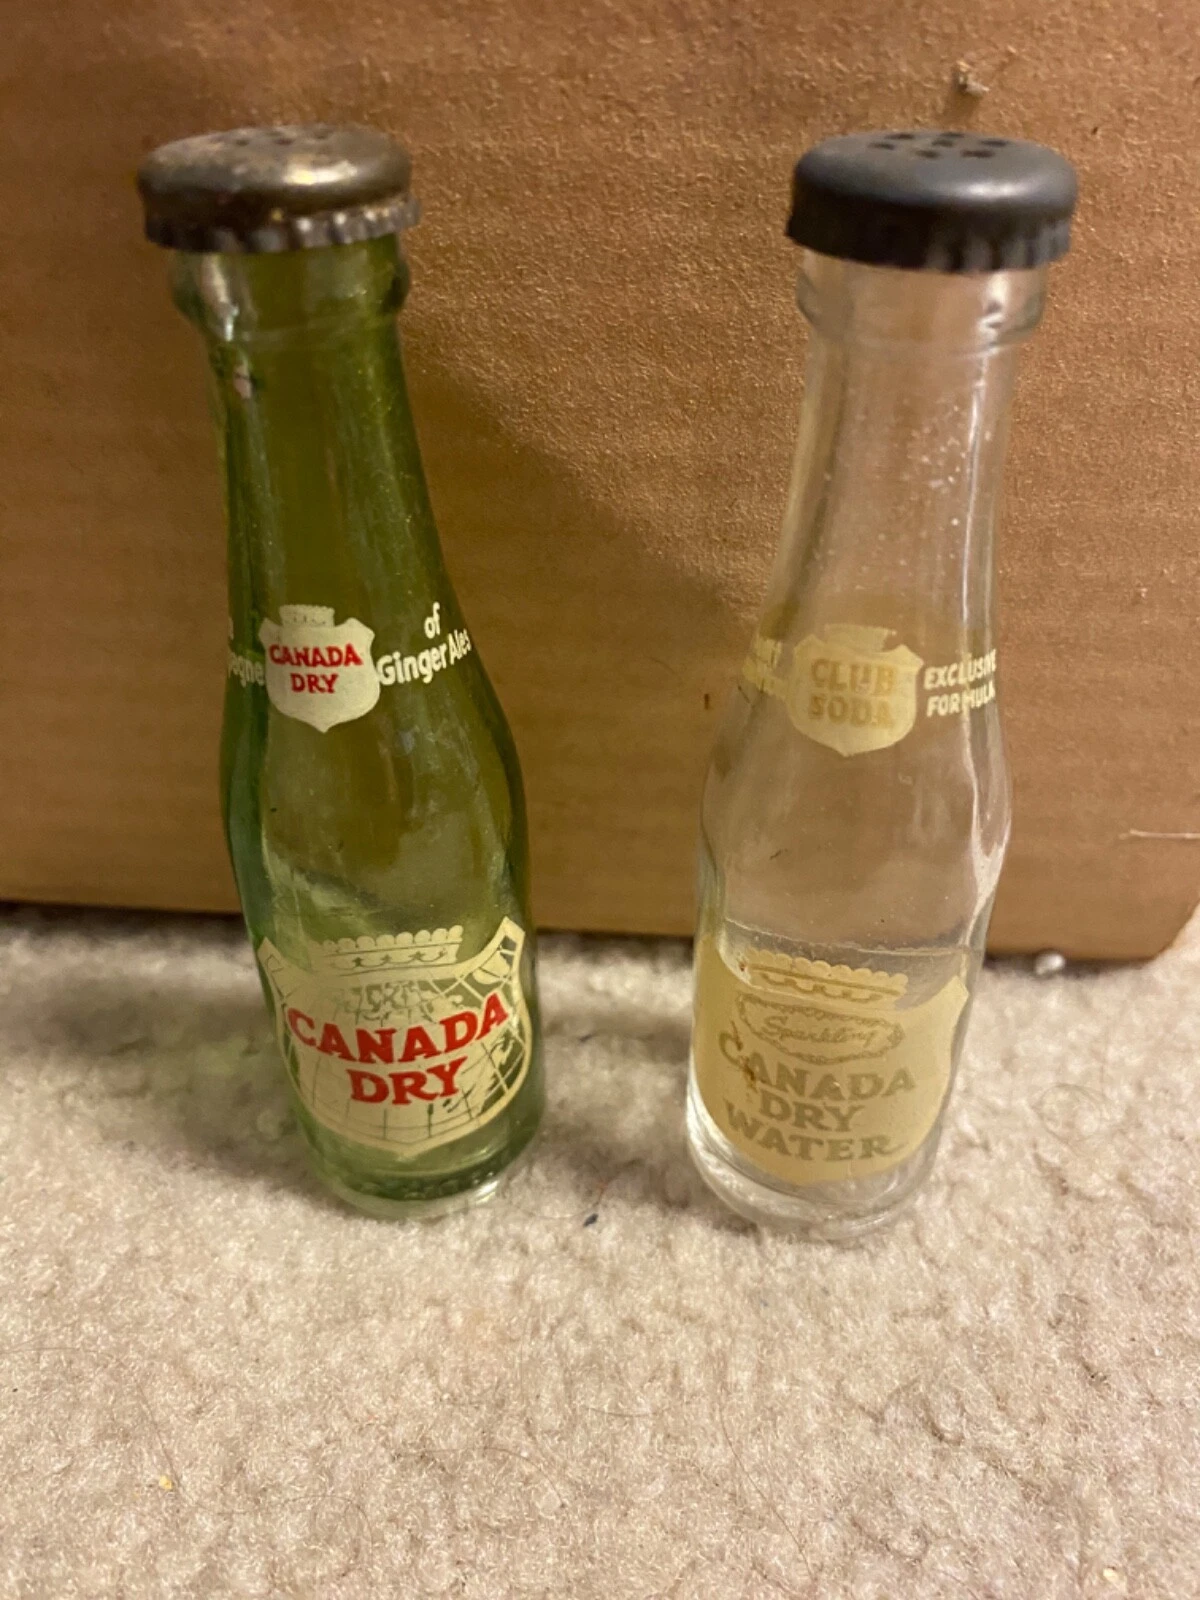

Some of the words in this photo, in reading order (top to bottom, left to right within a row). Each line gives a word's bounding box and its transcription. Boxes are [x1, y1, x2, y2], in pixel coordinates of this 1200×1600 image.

[424, 601, 441, 639] of
[268, 642, 364, 669] CANADA
[376, 642, 448, 686] Ginger
[449, 627, 472, 666] Ales
[290, 672, 340, 694] DRY
[811, 657, 895, 697] CLUB
[809, 693, 894, 729] SODA
[286, 991, 509, 1065] CANADA
[761, 1014, 879, 1049] Sparkling
[346, 1055, 469, 1106] DRY
[718, 1031, 917, 1102] CANADA
[723, 1100, 909, 1163] WATER
[758, 1089, 867, 1134] DRY
